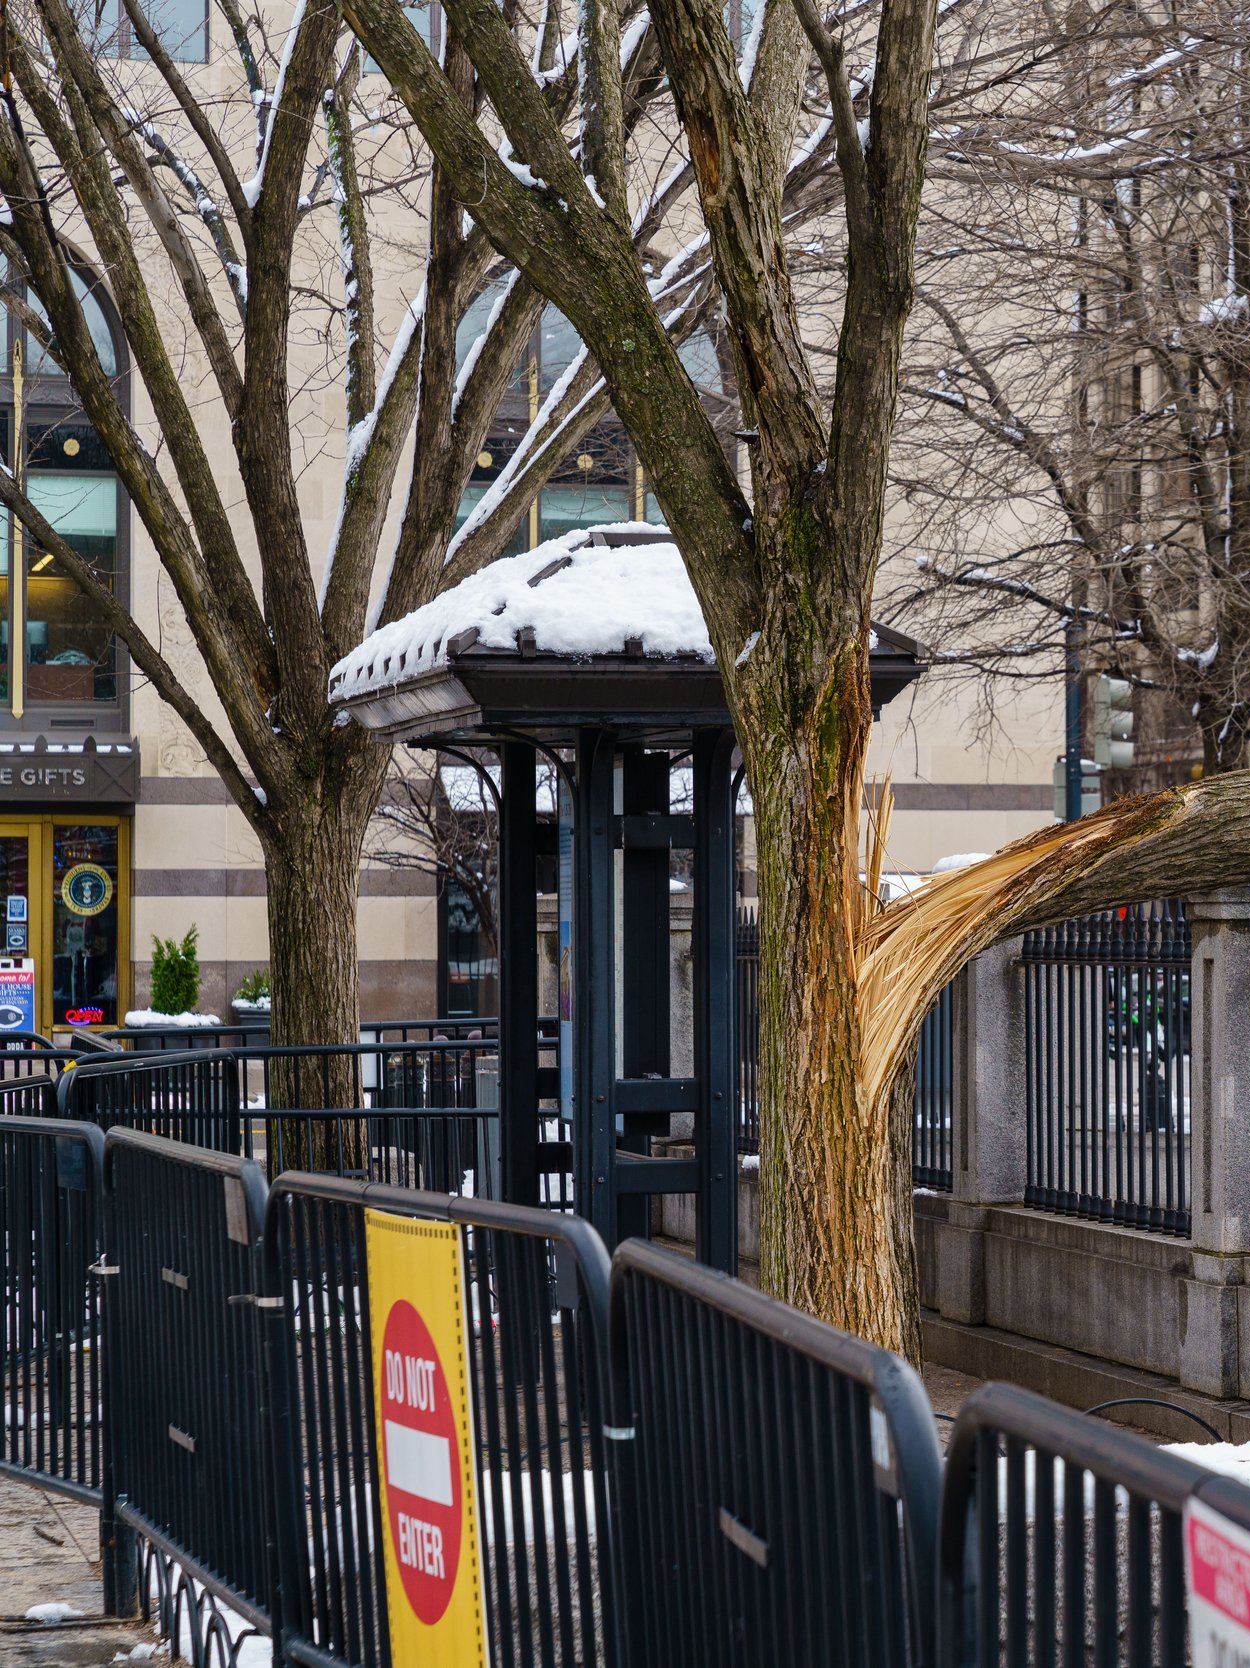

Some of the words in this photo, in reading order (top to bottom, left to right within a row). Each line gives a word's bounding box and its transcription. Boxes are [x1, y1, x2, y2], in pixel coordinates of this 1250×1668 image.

[20, 768, 86, 786] GIFTS
[65, 1009, 103, 1022] OPEN
[386, 1349, 404, 1404] DO
[405, 1355, 436, 1412] NOT
[398, 1511, 445, 1580] ENTER
